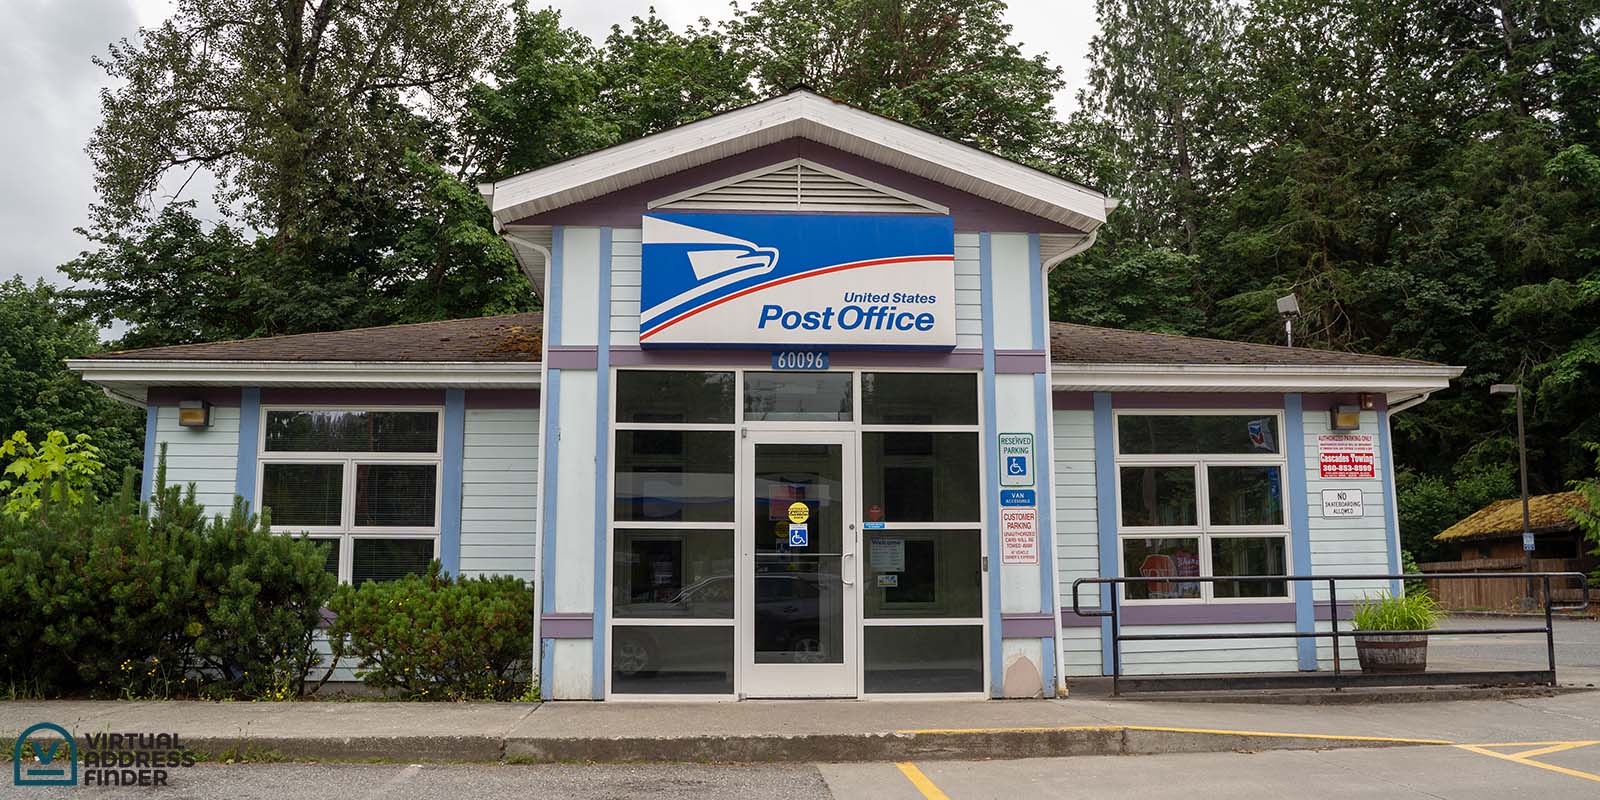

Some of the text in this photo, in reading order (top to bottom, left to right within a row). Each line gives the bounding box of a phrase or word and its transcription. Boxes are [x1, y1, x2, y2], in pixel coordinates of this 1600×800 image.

[844, 292, 937, 304] United States
[758, 304, 935, 331] Post Office
[777, 352, 824, 369] 60096
[1001, 437, 1031, 445] RESERVED
[1003, 446, 1029, 454] PARKING
[1320, 453, 1373, 464] Cascades Towing
[1337, 492, 1347, 501] NO
[1004, 512, 1034, 521] CUSTOMER
[1007, 521, 1032, 530] PARKING
